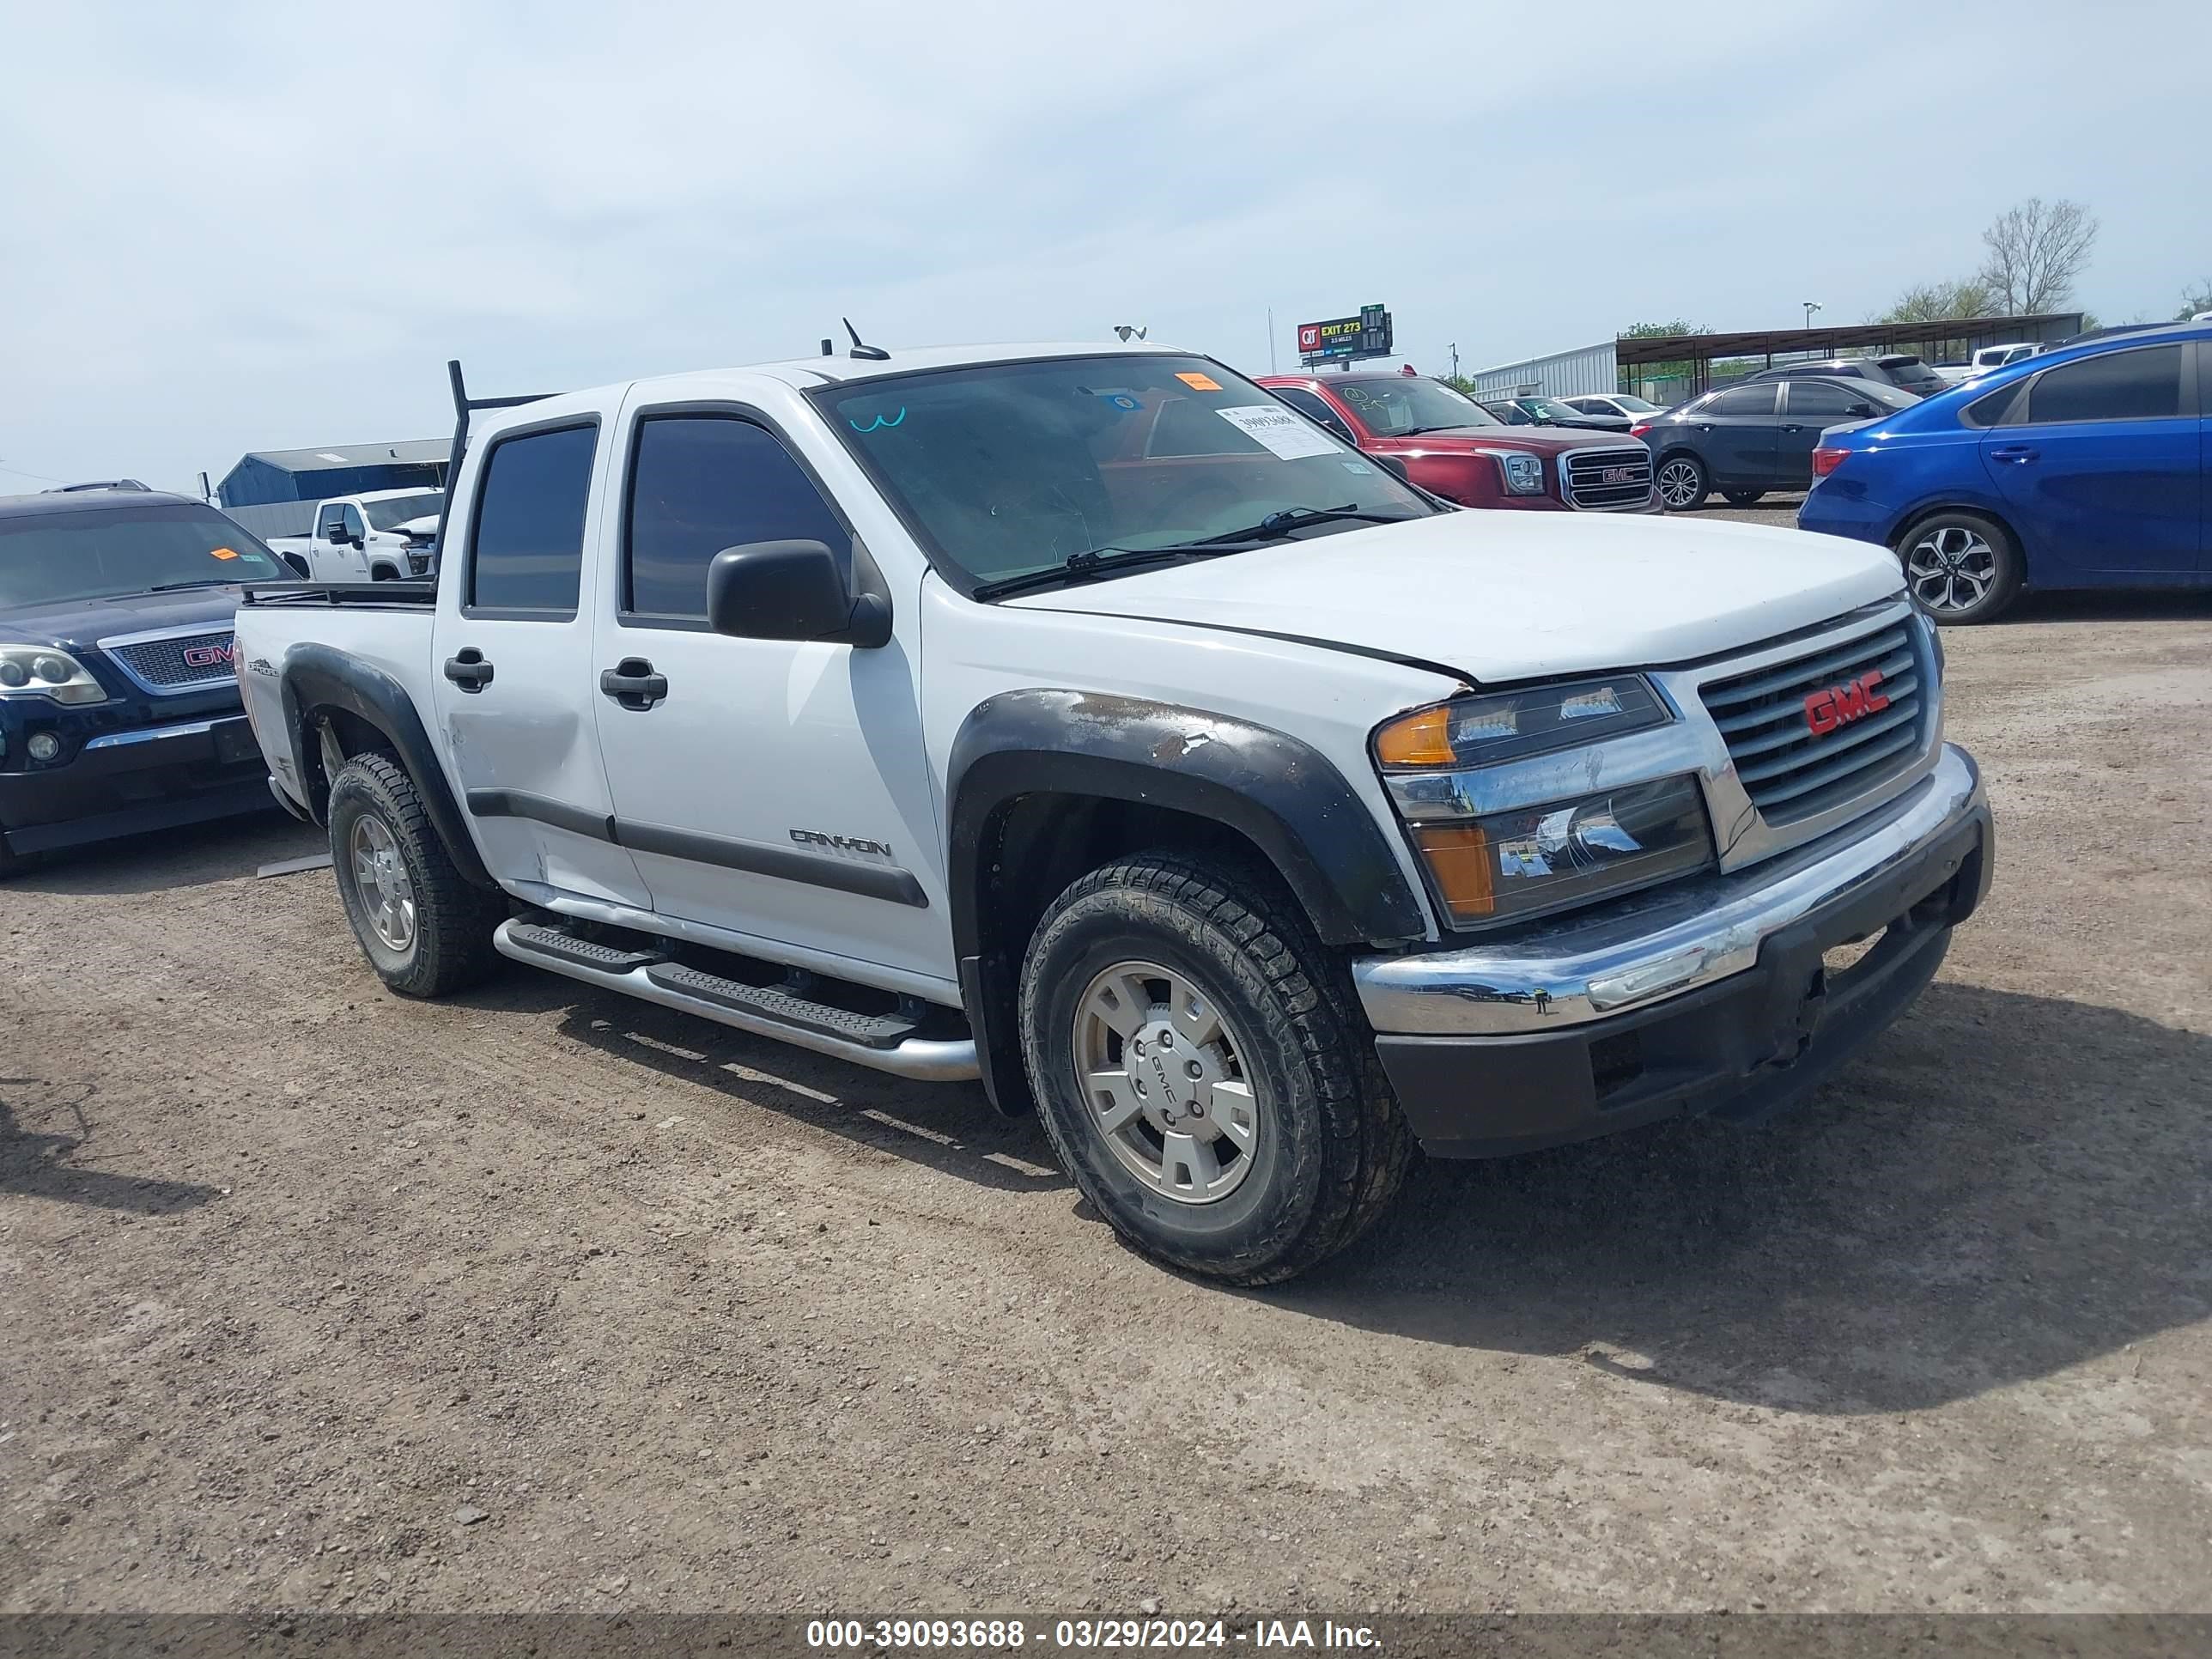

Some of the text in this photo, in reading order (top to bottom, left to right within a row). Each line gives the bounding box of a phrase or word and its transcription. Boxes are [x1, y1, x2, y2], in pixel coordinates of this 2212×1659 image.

[1302, 330, 1316, 345] QT
[1322, 322, 1361, 337] EXIT 273
[1602, 468, 1635, 482] GMC
[184, 644, 235, 666] GM
[1804, 670, 1890, 736] GMC
[789, 828, 892, 857] CANYON
[1152, 1056, 1177, 1104] GMC
